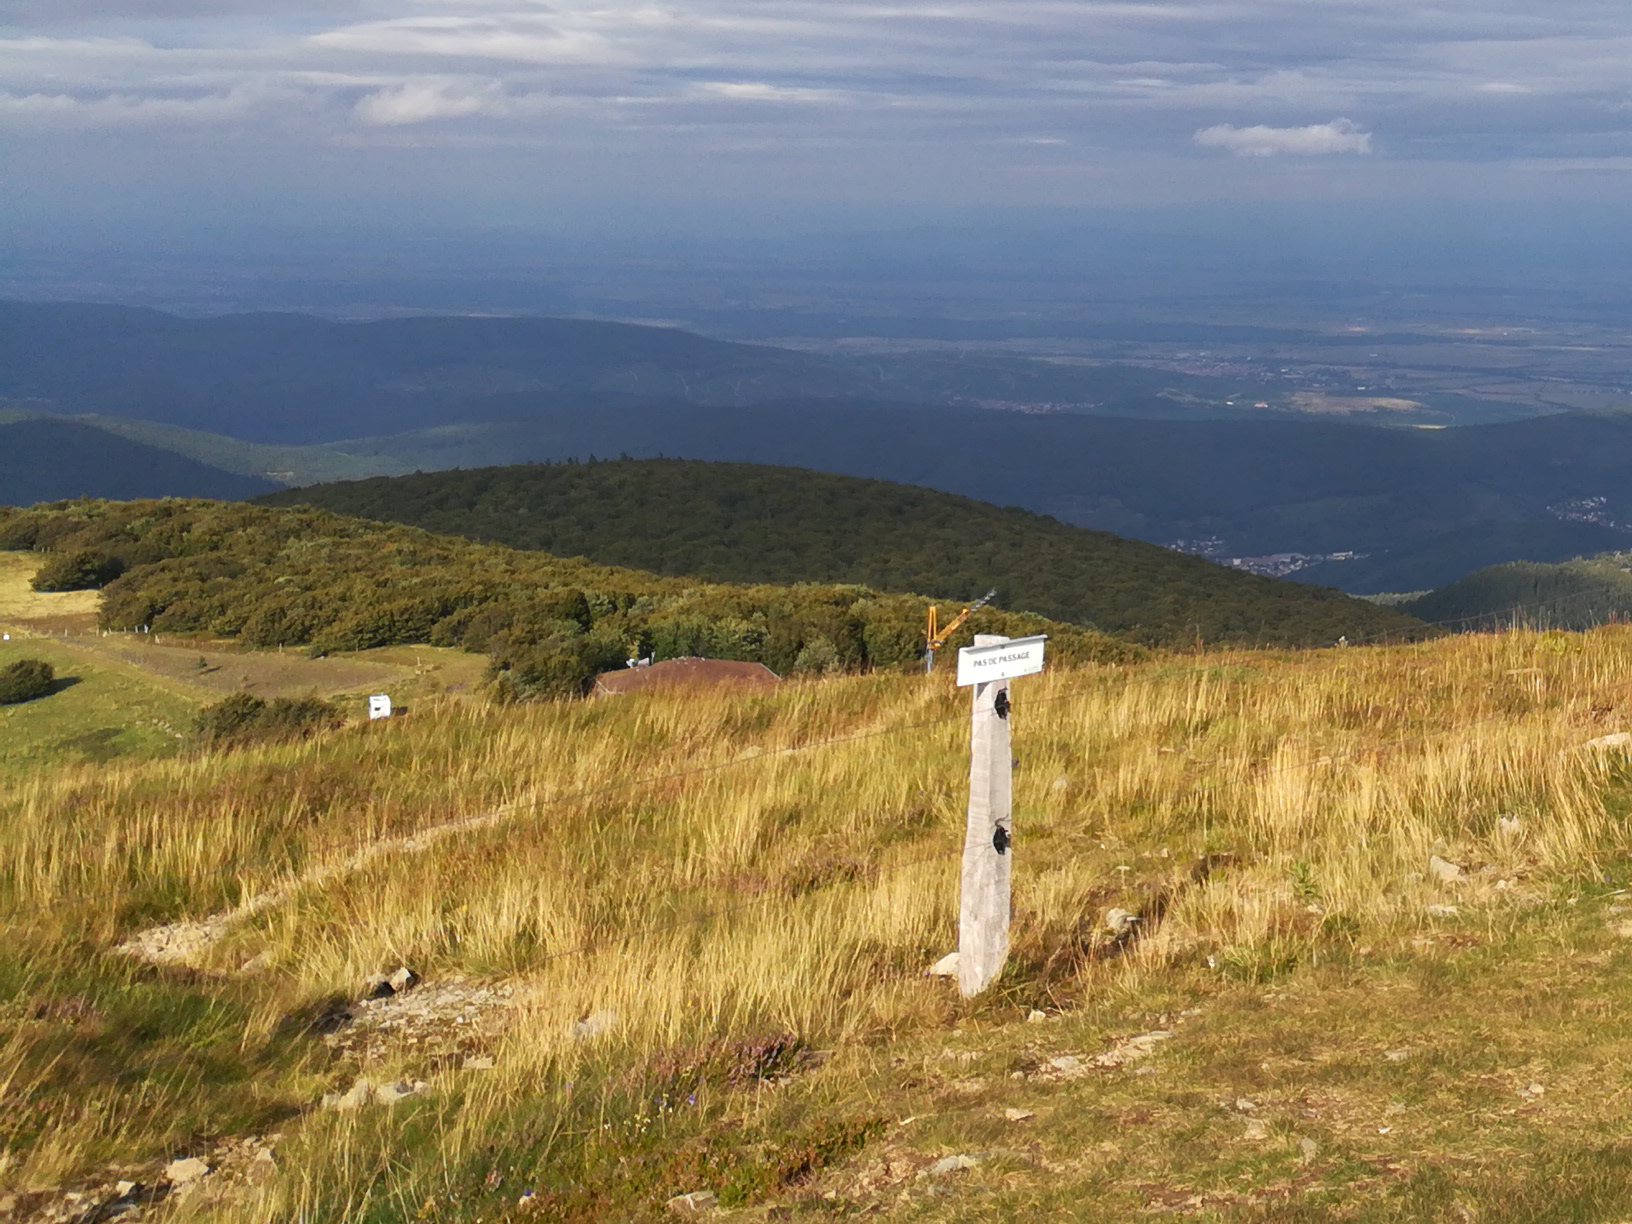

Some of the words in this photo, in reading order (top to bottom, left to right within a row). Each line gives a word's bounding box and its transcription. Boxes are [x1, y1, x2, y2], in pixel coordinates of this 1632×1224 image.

[973, 658, 987, 668] PAS
[988, 657, 998, 666] DE
[999, 651, 1030, 664] PASSAGE
